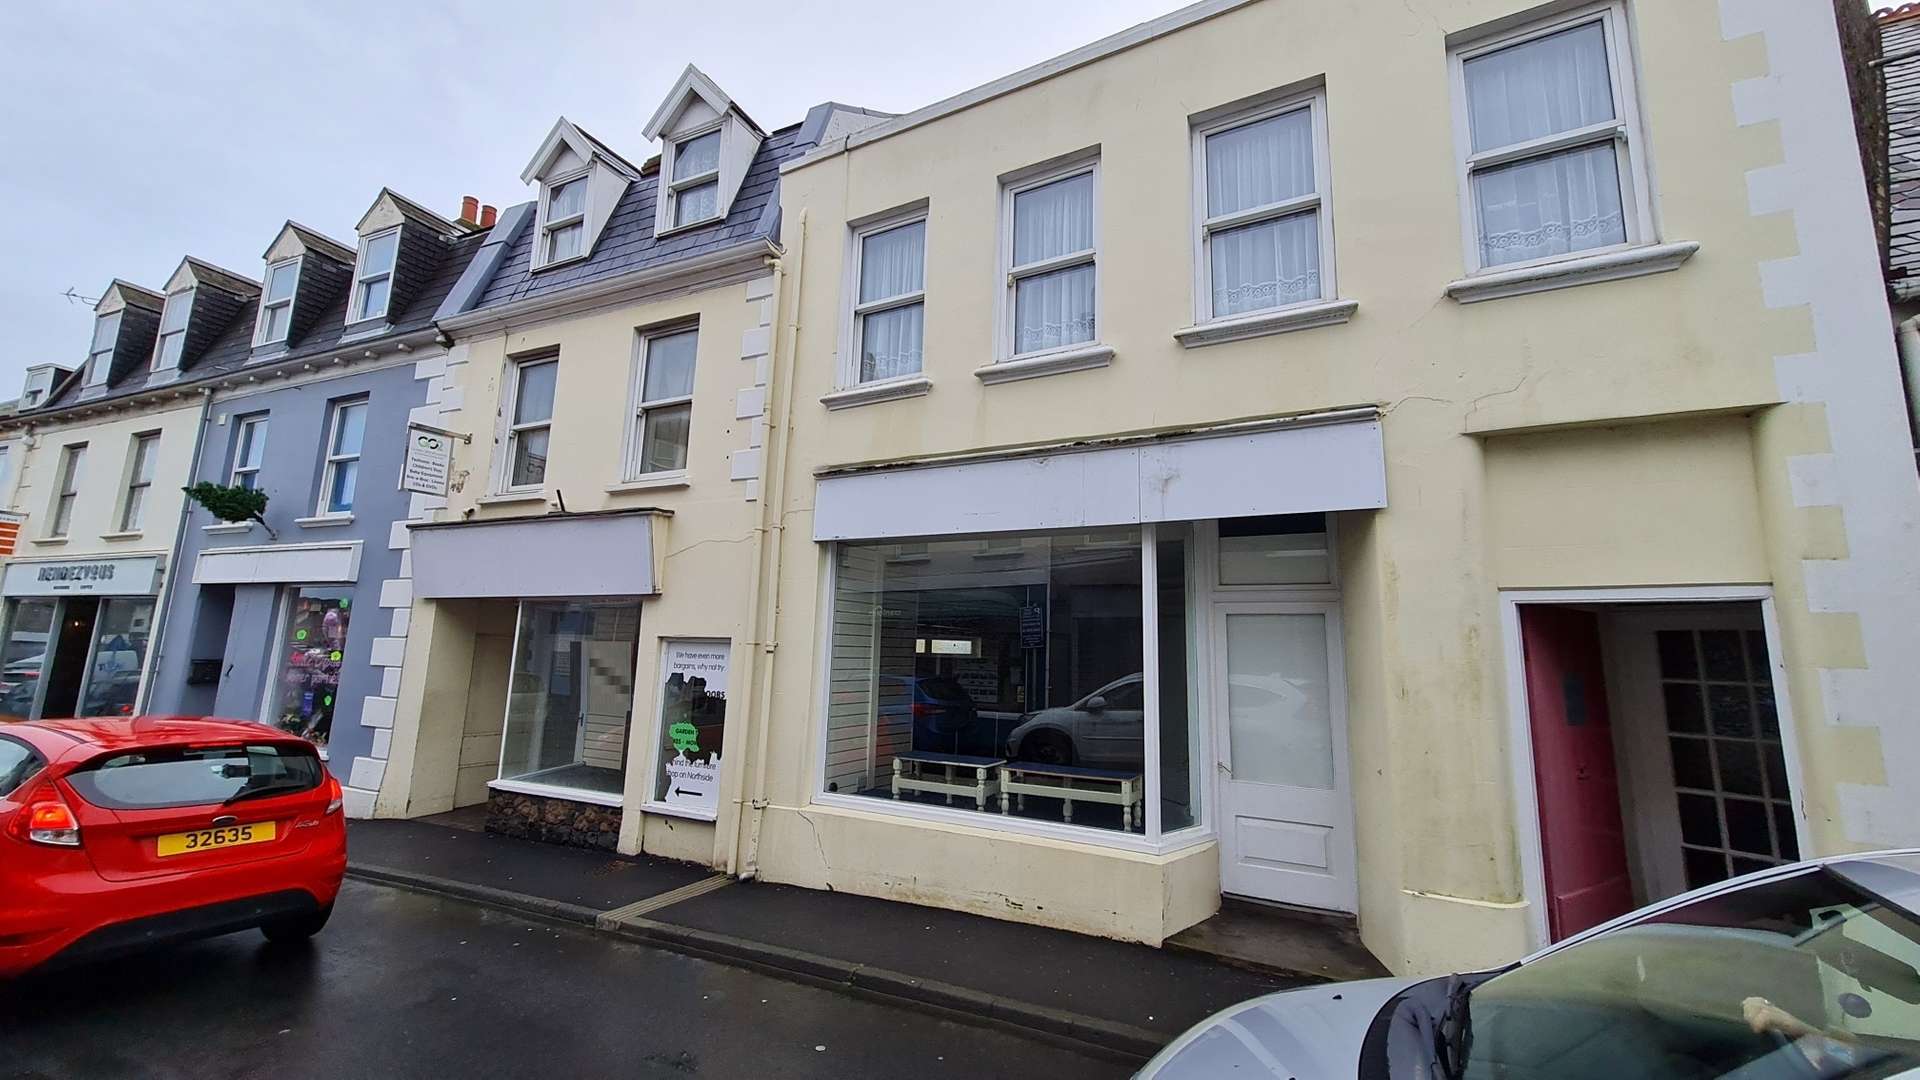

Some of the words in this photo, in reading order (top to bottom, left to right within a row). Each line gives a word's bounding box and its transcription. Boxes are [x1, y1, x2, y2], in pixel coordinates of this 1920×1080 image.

[37, 564, 115, 581] RENDEZVOUS
[697, 663, 708, 671] why
[688, 771, 714, 781] Northside
[185, 826, 252, 849] 32635
